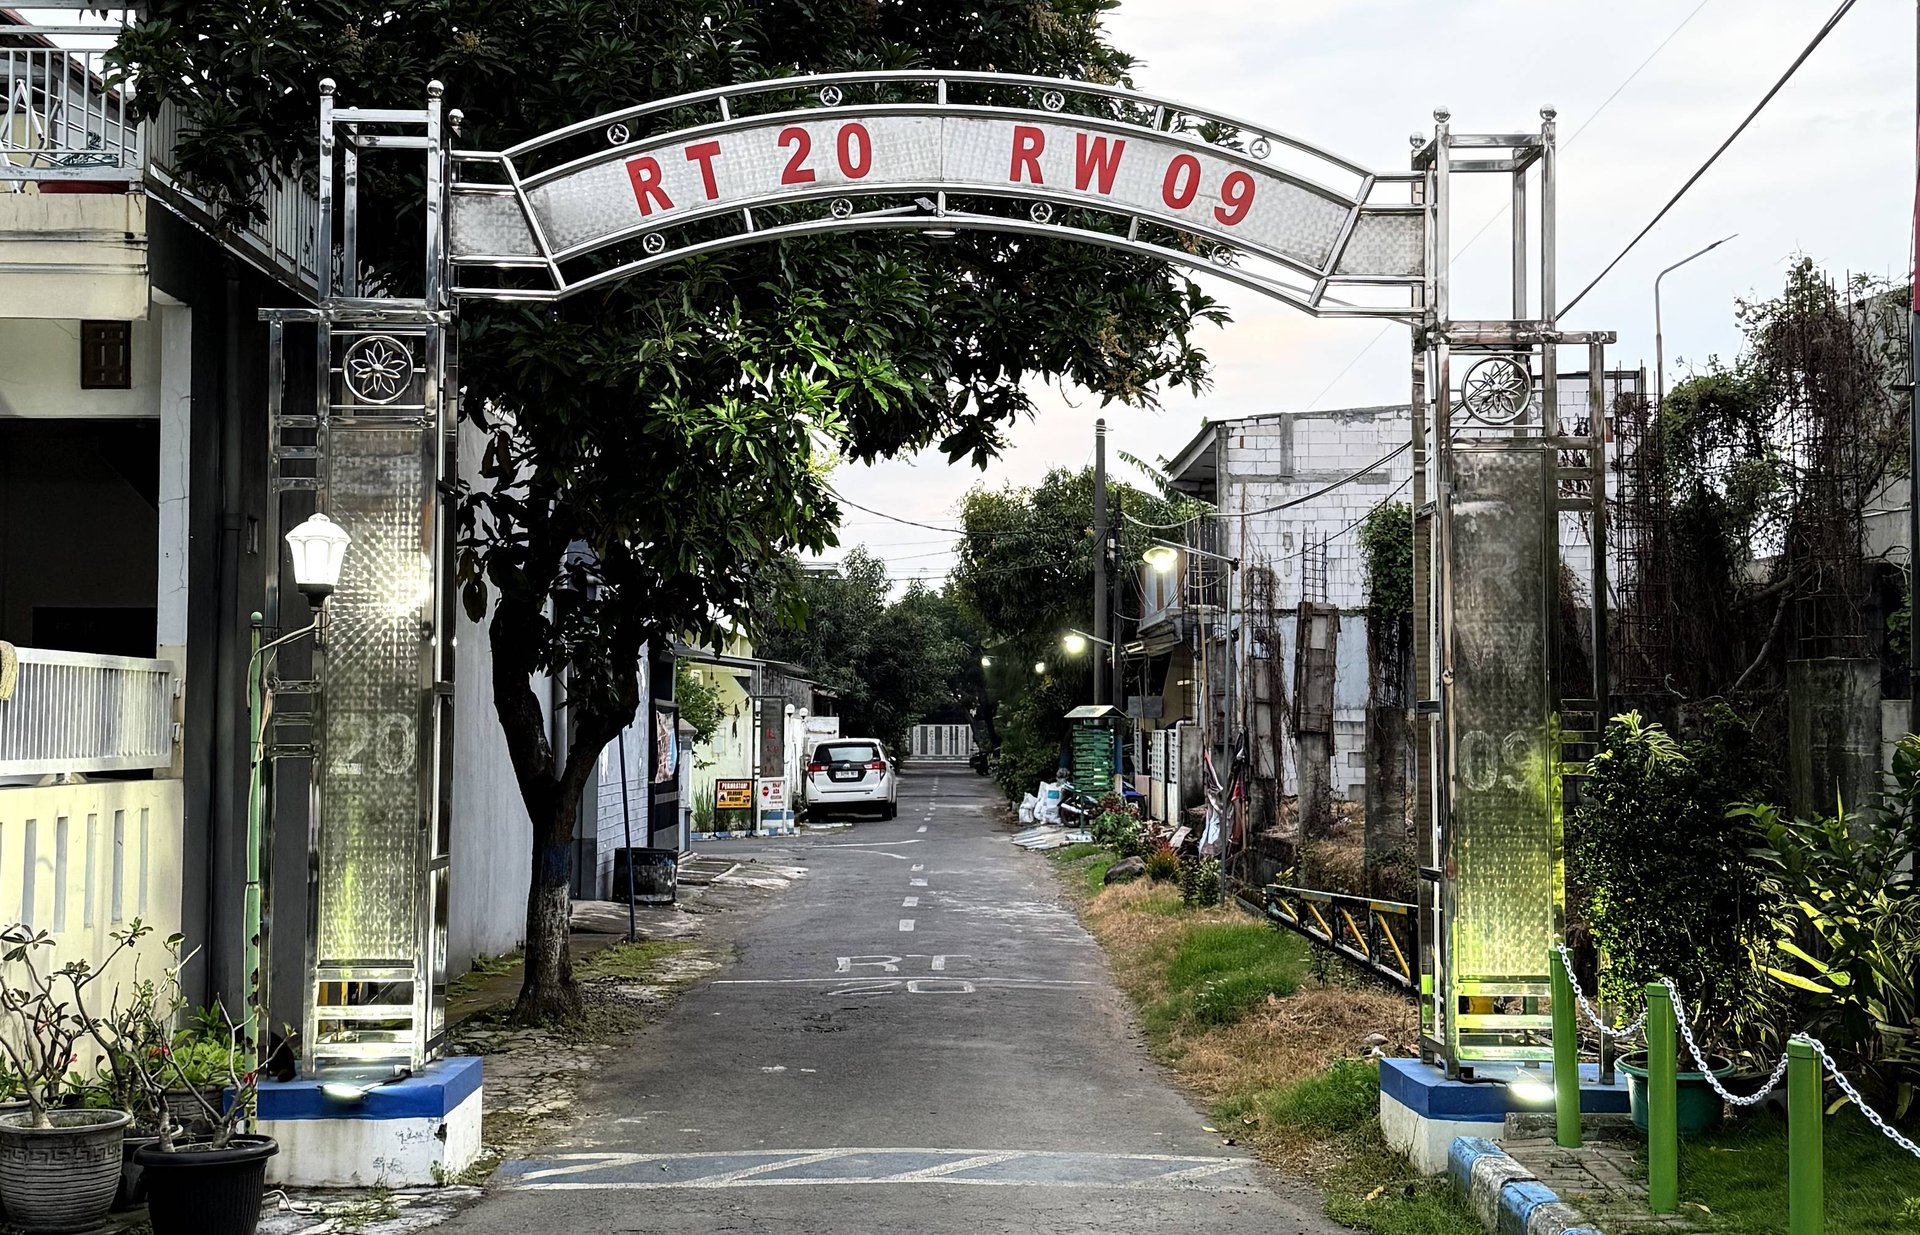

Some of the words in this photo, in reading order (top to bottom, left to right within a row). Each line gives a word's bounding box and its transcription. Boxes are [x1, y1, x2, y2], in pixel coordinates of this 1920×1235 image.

[626, 141, 721, 217] RT
[779, 122, 872, 185] 20
[1009, 125, 1126, 195] RW
[1162, 154, 1256, 226] 09
[330, 712, 416, 775] 20
[834, 954, 972, 973] RT
[827, 979, 977, 996] 20
